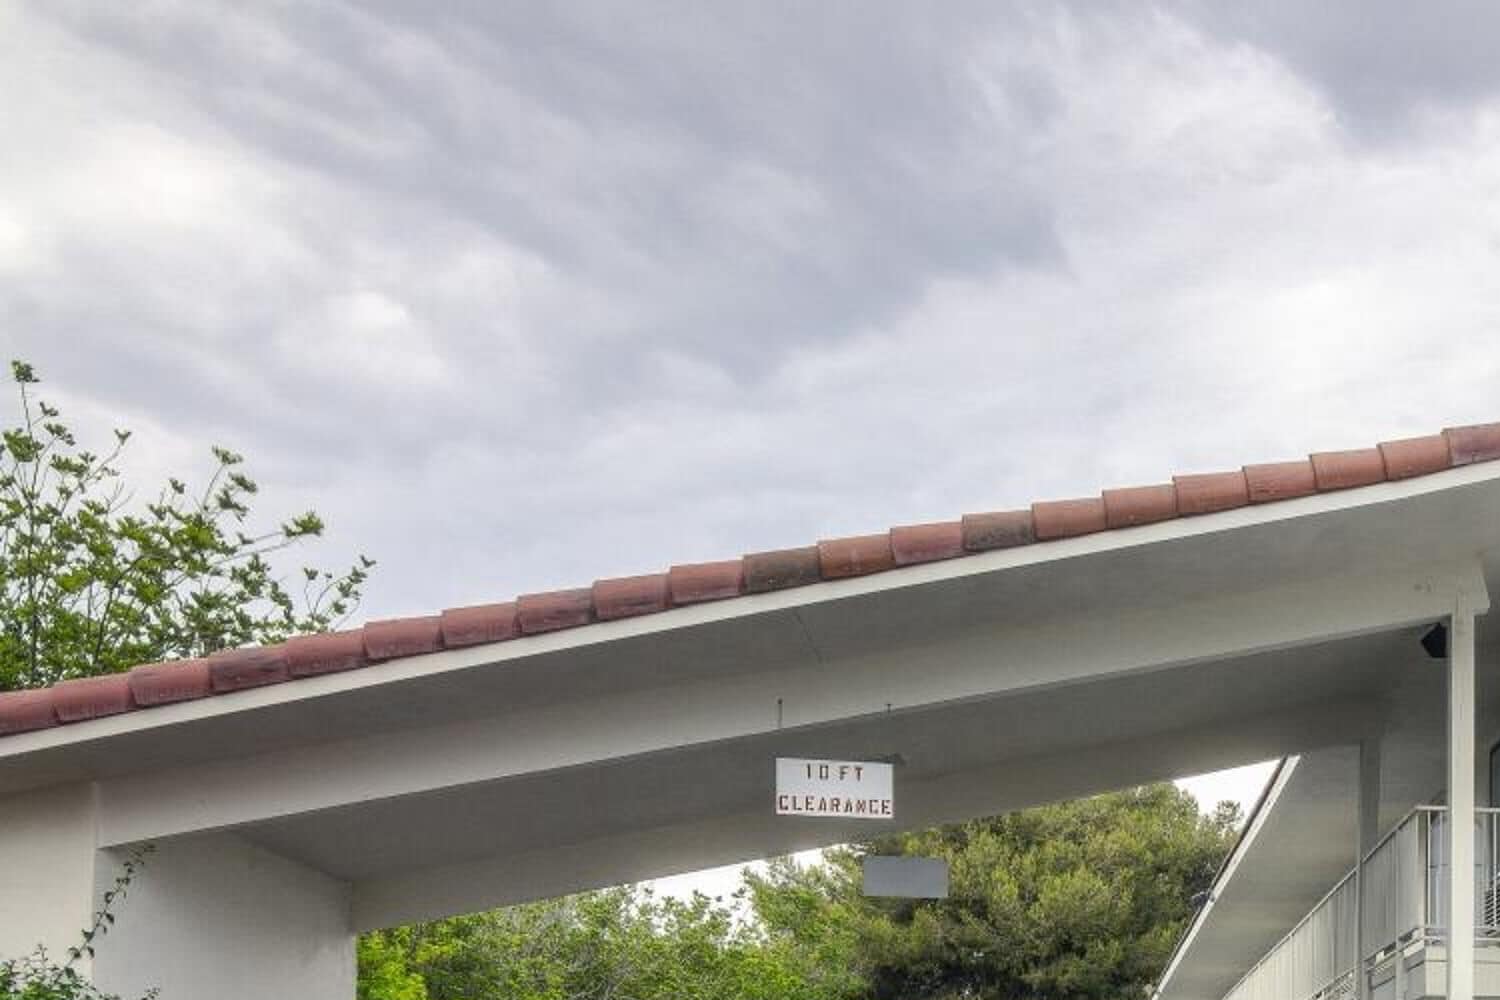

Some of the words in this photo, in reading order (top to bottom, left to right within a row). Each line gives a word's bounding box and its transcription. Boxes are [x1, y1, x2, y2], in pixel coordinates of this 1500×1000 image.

[806, 763, 829, 780] 10
[839, 766, 864, 781] FT
[778, 795, 892, 815] CLEARANCE
